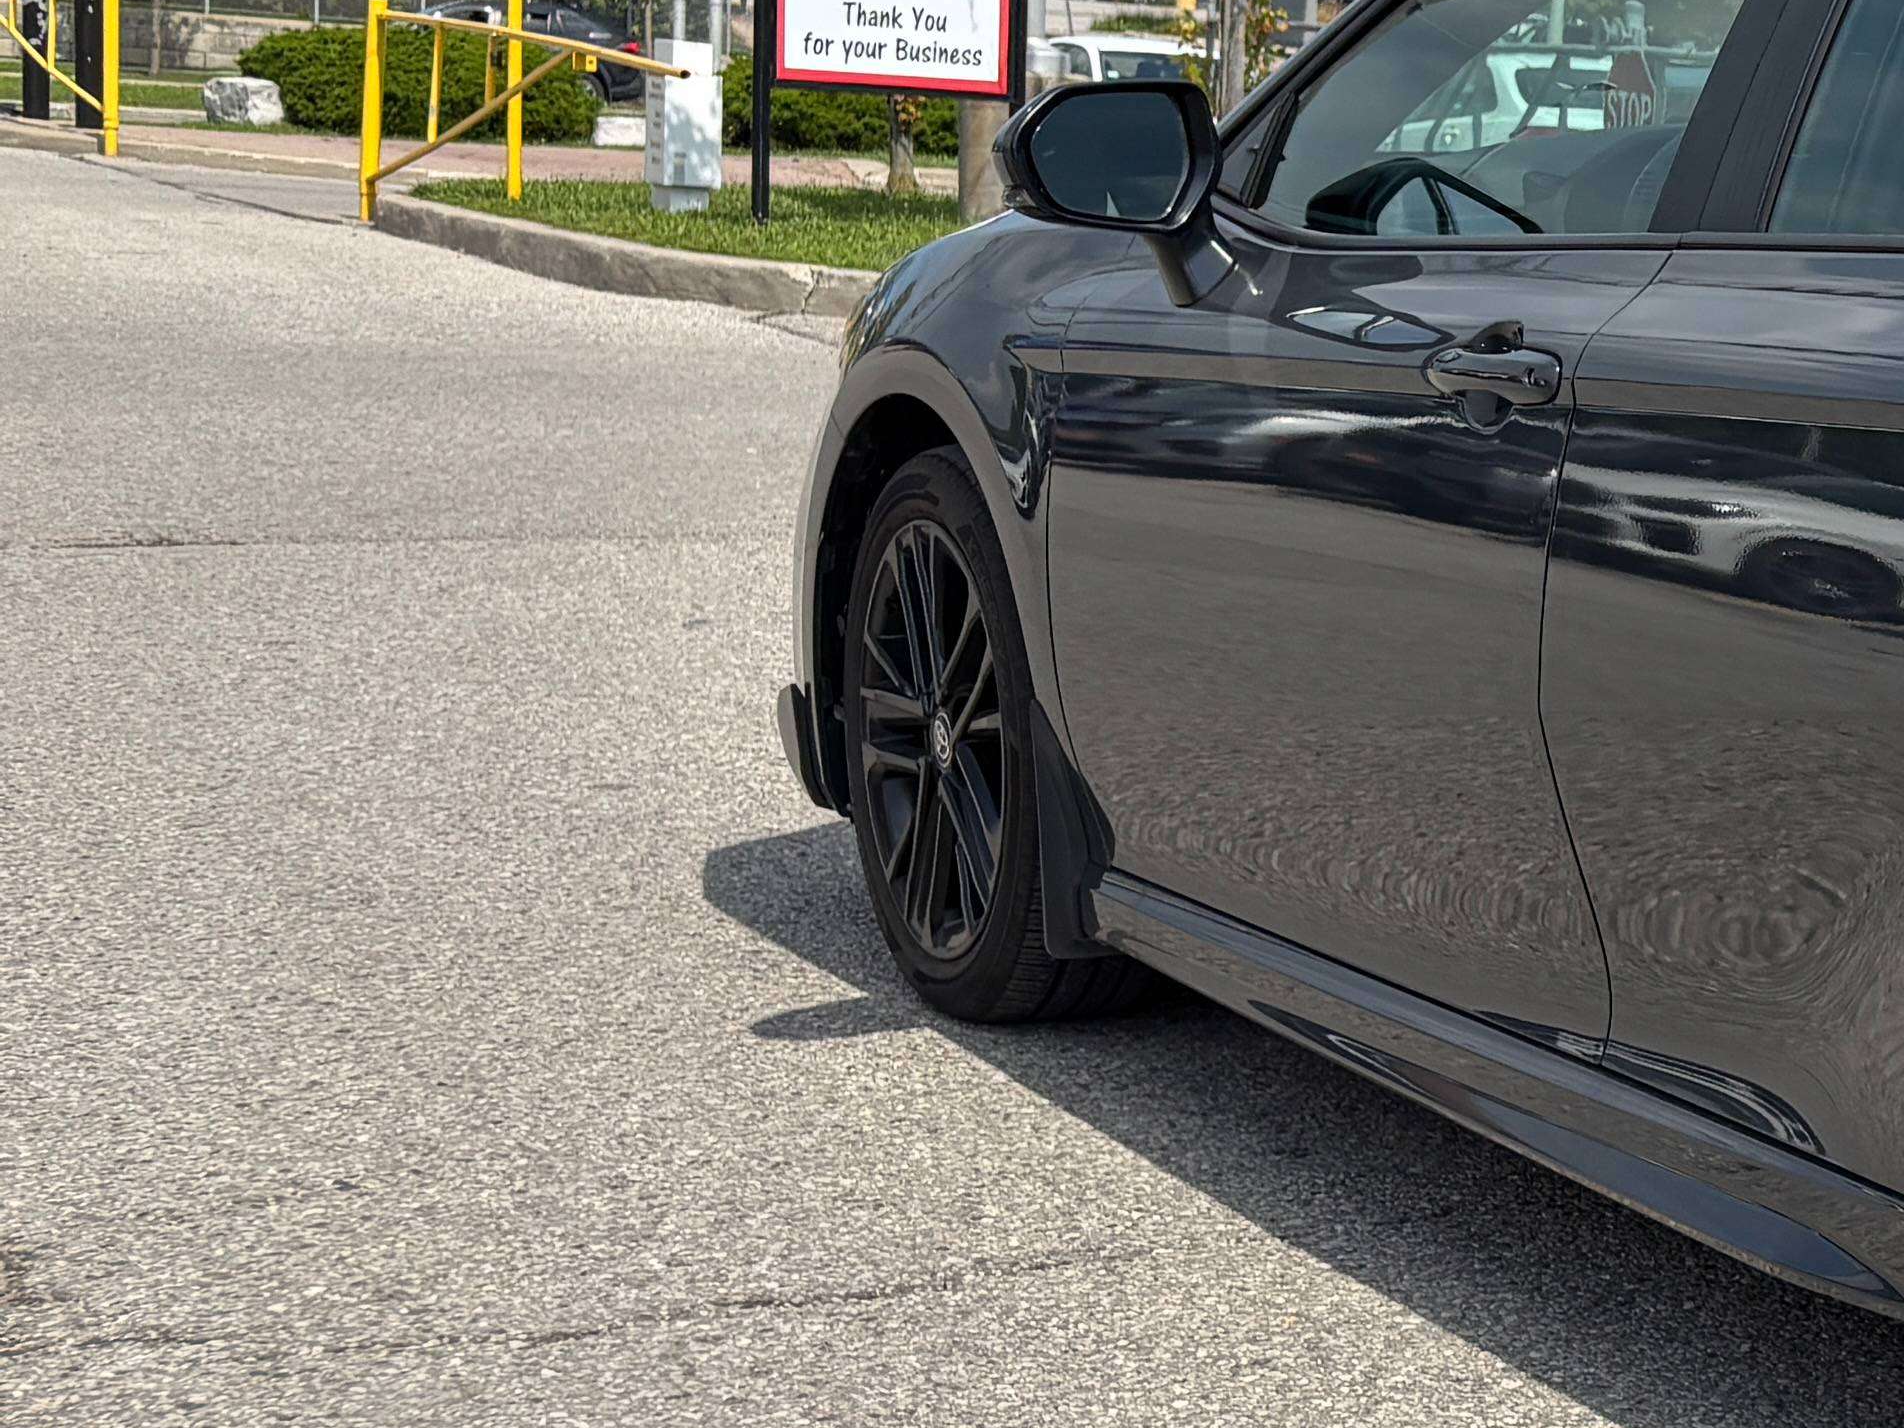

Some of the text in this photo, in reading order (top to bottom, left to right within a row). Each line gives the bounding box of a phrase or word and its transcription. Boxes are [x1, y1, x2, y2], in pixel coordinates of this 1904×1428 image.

[843, 1, 947, 33] Thank You
[803, 31, 982, 67] for your Business
